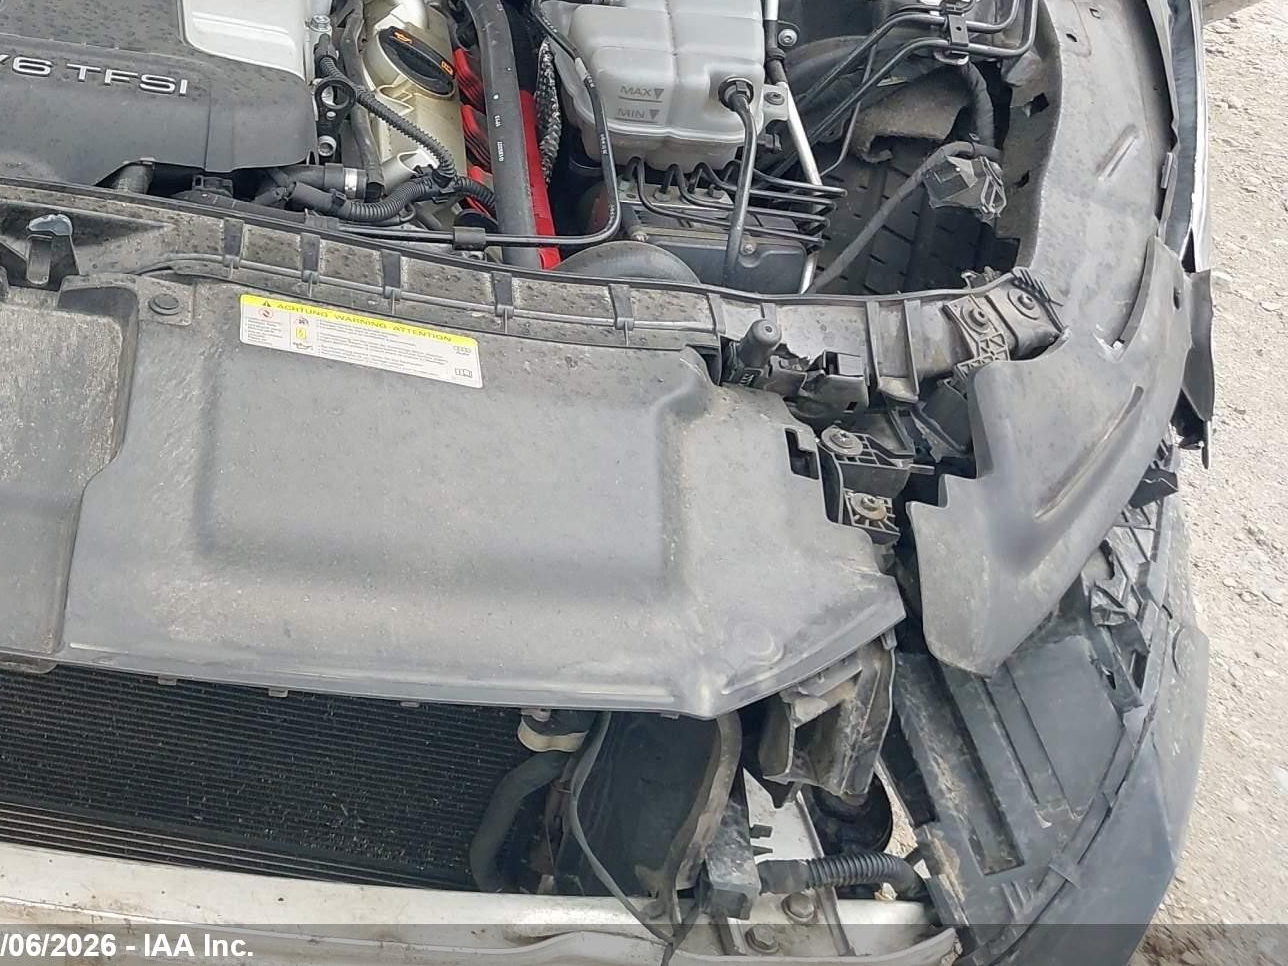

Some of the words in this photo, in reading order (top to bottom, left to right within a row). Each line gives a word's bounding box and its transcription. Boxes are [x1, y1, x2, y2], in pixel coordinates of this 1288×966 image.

[66, 63, 189, 96] TFSI
[619, 85, 652, 97] MAX
[617, 108, 645, 119] MIN
[276, 303, 329, 318] ACHTUNG
[334, 314, 387, 329] WARNING
[392, 326, 453, 342] ATTENTION
